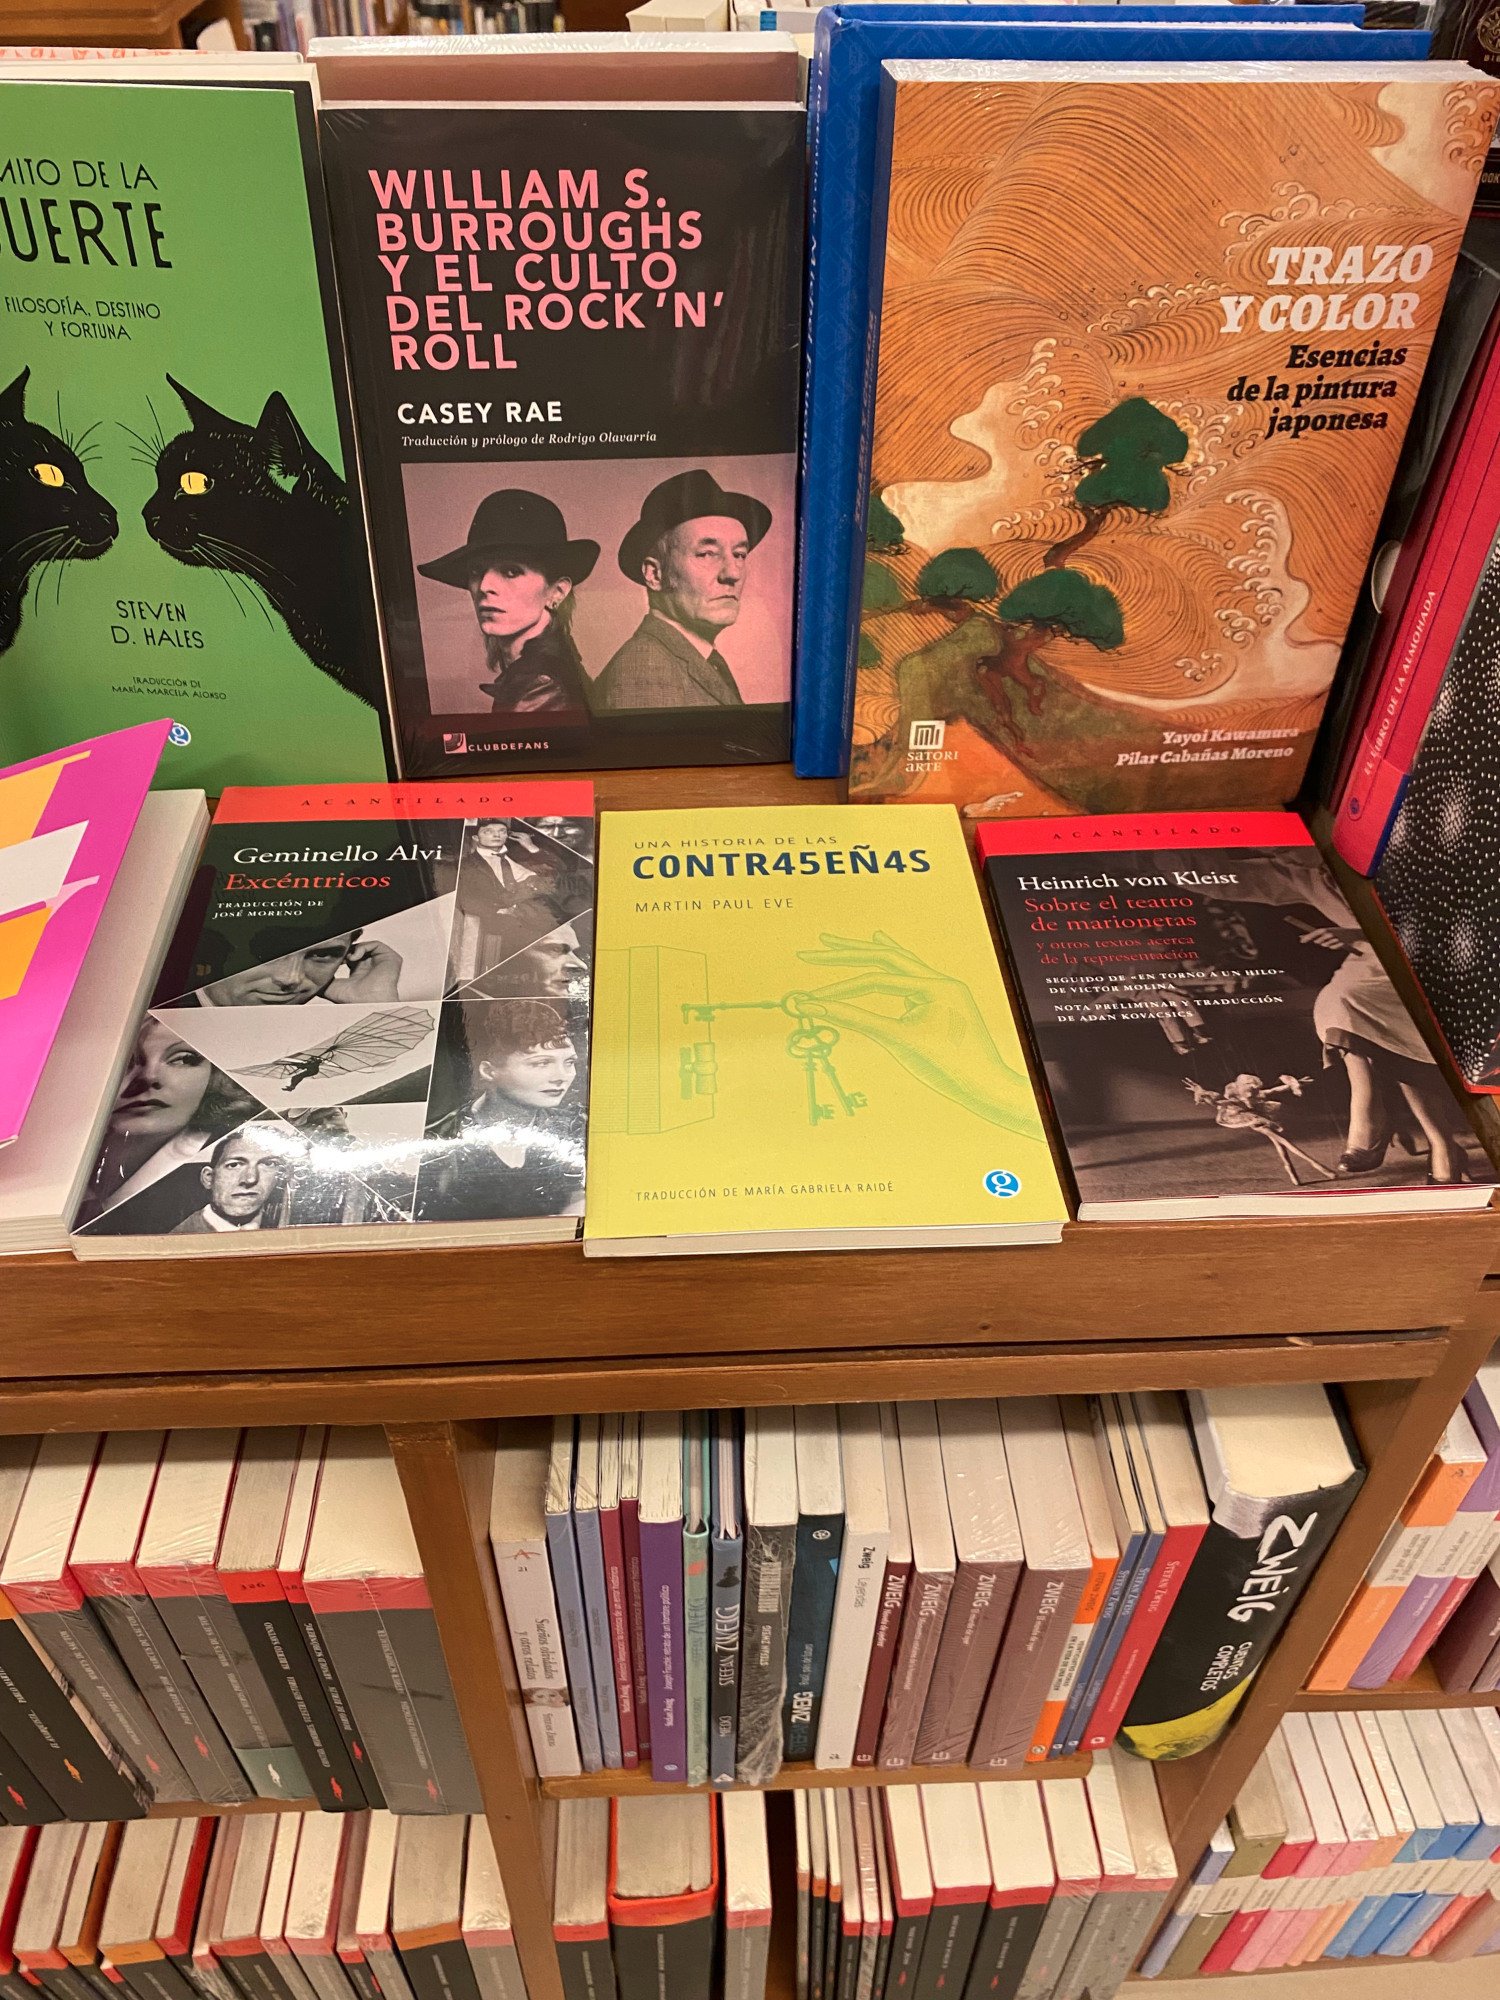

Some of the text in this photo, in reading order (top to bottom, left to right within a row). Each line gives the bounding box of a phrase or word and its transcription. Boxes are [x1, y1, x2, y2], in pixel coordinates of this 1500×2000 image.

[73, 161, 109, 188] DE
[120, 162, 158, 190] LA
[369, 168, 667, 209] WILLIAM S.
[0, 197, 172, 268] UERTE
[376, 211, 702, 252] BURROUGHS
[378, 252, 677, 292] Y EL CULTO
[1267, 245, 1433, 286] TRAZO
[6, 296, 161, 319] FILOSOFÍA, DESTINO
[387, 295, 482, 332] DEL
[1219, 293, 1420, 333] Y COLOR
[44, 321, 131, 341] Y FORTUNA
[391, 333, 517, 370] ROLL
[1286, 340, 1408, 368] Esencias
[1227, 375, 1397, 408] de la pintura
[397, 401, 563, 425] CASEY RAE
[1265, 407, 1388, 439] japonesa
[401, 431, 657, 448] Traducción y prólogo de Rodrigo Olavarría
[116, 600, 187, 622] STEVEN
[111, 625, 205, 650] D. HALES
[1387, 697, 1400, 717] DE
[1394, 677, 1406, 697] LA
[1402, 591, 1436, 675] ALMOHADA
[147, 688, 189, 698] MARCELA
[1162, 728, 1299, 747] Yayoi Kawamura
[1115, 745, 1293, 769] Pilar Cabañas Moreno
[301, 795, 514, 807] ACANTILADO
[634, 836, 837, 849] UNA HISTORIA DE LAS
[1053, 826, 1242, 840] ACANTILADO
[233, 845, 442, 864] Geminello Alvi
[224, 873, 391, 891] Excéntricos
[1017, 870, 1239, 891] Heinrich von Kleist
[212, 909, 303, 919] JOSÉ MORENO
[217, 899, 324, 909] TRADUCCIÓN DE
[635, 898, 794, 913] MARTIN PAUL EVE
[1024, 895, 1194, 913] Sobre el teatro
[1030, 914, 1197, 933] de marionetas
[1036, 936, 1195, 953] y otros textos acerca
[1040, 949, 1200, 966] de la representación
[1045, 976, 1104, 985] SEGUIDO
[1159, 971, 1205, 980] TORNO
[1209, 970, 1218, 978] A
[1221, 969, 1241, 977] UN
[1049, 987, 1067, 995] DE
[1123, 982, 1176, 992] MOLINA
[1054, 994, 1284, 1012] NOTA PRELIMINAR Y TRADUCCIÓN
[1057, 1015, 1076, 1023] DE
[1121, 1010, 1195, 1021] KOVACSICS
[636, 1181, 894, 1202] TRADUCCIÓN DE MARÍA GABRIELA RAIDÉ
[858, 1546, 876, 1569] Zweig
[854, 1577, 870, 1608] Leyendas
[885, 1574, 906, 1608] ZWEIG
[975, 1574, 996, 1608] ZWEIG
[1132, 1567, 1151, 1594] STEFAN
[1147, 1560, 1182, 1613] STEFAN ZWEIG
[919, 1583, 942, 1617] ZWEIG
[1039, 1581, 1064, 1614] ZWEIG
[714, 1603, 740, 1687] STEFAN ZWEIG
[1200, 1645, 1235, 1692] COMPLETOS
[1222, 1641, 1254, 1680] CUENTOS
[791, 1691, 814, 1723] ZWEIG
